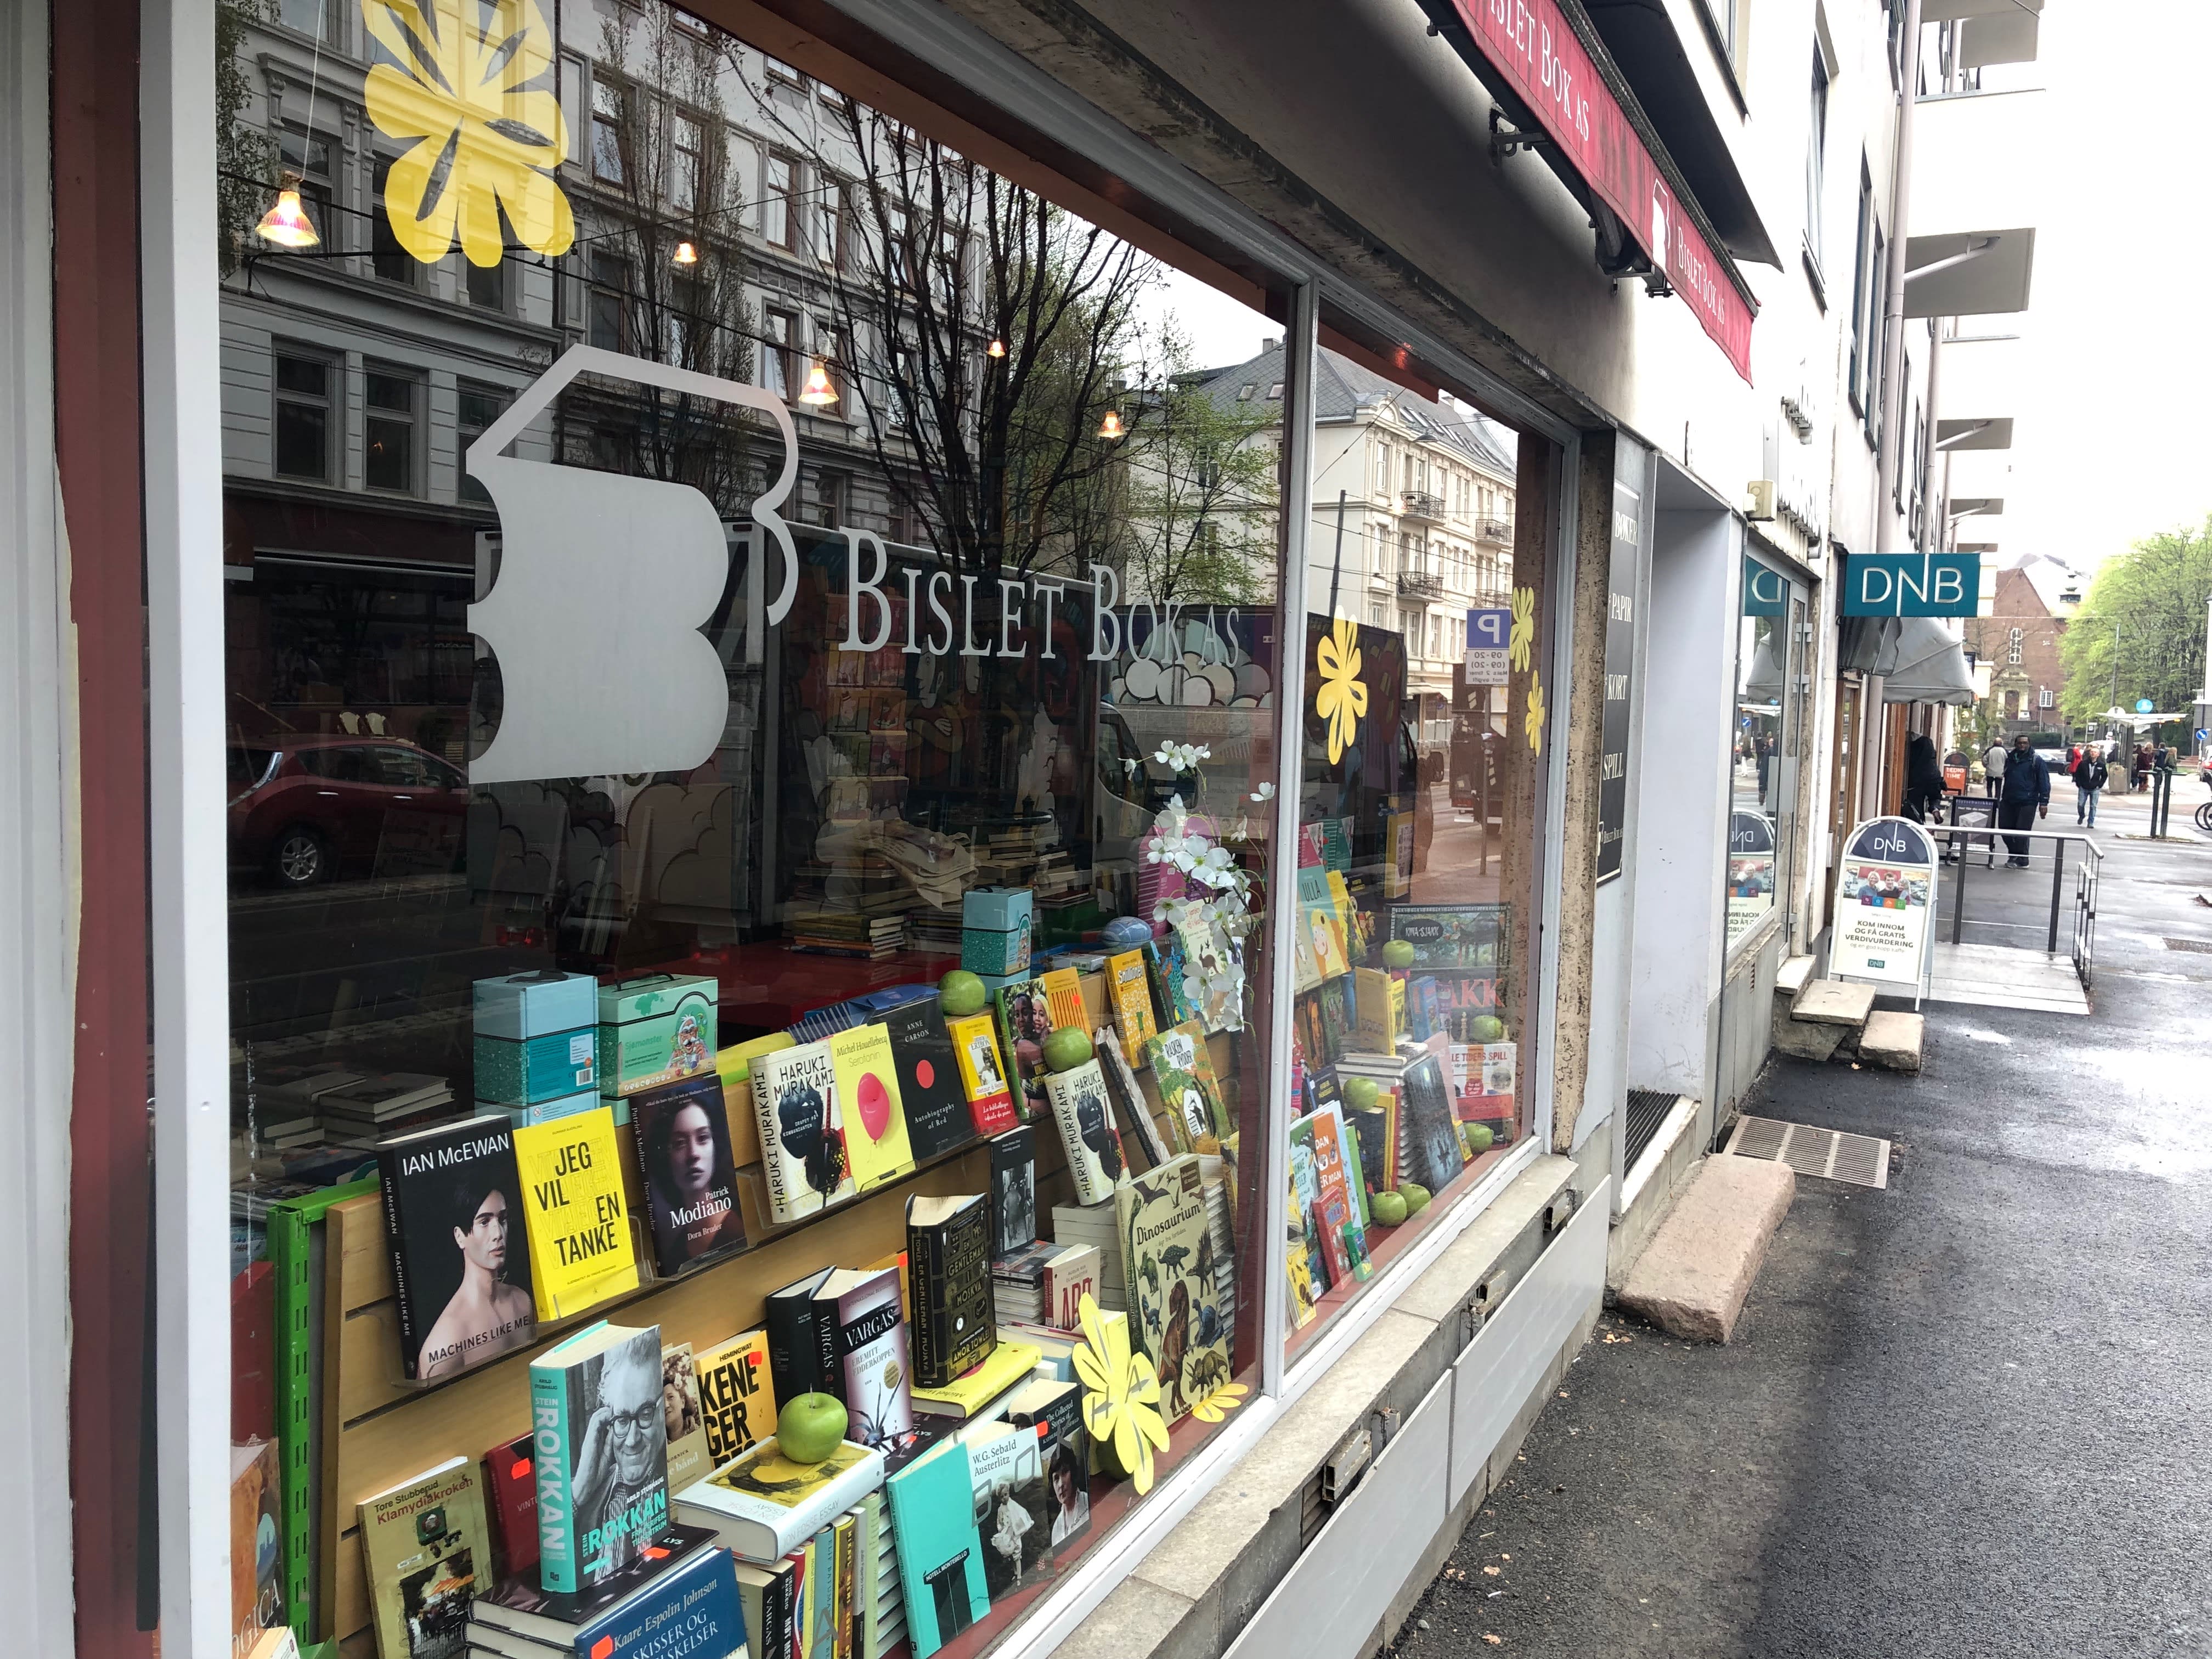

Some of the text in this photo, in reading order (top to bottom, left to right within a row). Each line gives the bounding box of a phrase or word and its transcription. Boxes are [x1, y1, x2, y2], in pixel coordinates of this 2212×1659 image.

[1542, 20, 1589, 141] BOK AS
[1678, 226, 1725, 325] BISLET BOK AS
[1615, 511, 1638, 546] BØKER
[838, 526, 1239, 669] BISLET BOK AS
[1862, 554, 1965, 617] DNB
[1611, 593, 1632, 622] PAPIR
[1608, 674, 1628, 701] KORT
[1602, 753, 1623, 781] SPILL
[1302, 879, 1322, 902] ULLA
[1845, 934, 1914, 948] VERDIVURDERING
[1877, 923, 1905, 931] INNOM
[1878, 930, 1905, 939] GRATIS
[905, 1029, 930, 1042] CARSON
[906, 1020, 923, 1031] ANNE
[836, 1036, 888, 1057] Michel Houellebecq
[1488, 1052, 1508, 1060] SPILL
[779, 1055, 826, 1082] HARUKI
[1073, 1070, 1101, 1092] HARUKI
[774, 1069, 835, 1101] MURAKAMI
[1071, 1081, 1107, 1107] MURAKAMI
[632, 1107, 641, 1135] Patrick
[914, 1103, 955, 1124] Autobiography
[928, 1116, 947, 1130] of Red
[754, 1072, 785, 1206] HARUKI MURAKAMI
[1054, 1084, 1091, 1192] HARUKI MURAKAMI
[403, 1132, 509, 1176] IAN McEWAN
[555, 1142, 592, 1176] JEG
[636, 1137, 646, 1172] Modiano
[1328, 1170, 1342, 1183] MAN
[534, 1180, 570, 1211] VIL
[596, 1191, 621, 1224] EN
[704, 1186, 729, 1201] Patrick
[387, 1195, 398, 1234] McEWAN
[669, 1197, 731, 1229] Modiano
[1136, 1204, 1201, 1246] Dinosaurium
[554, 1221, 618, 1267] TANKE
[687, 1222, 723, 1241] Dora Bruder
[947, 1242, 985, 1277] GENTLEMAN
[394, 1252, 405, 1299] MACHINES
[404, 1323, 410, 1336] ME
[956, 1280, 982, 1307] MOSKVA
[428, 1315, 529, 1363] MACHINES LIKE ME
[820, 1315, 834, 1368] VARGAS
[845, 1308, 895, 1347] VARGAS
[719, 1342, 752, 1362] HEMINGWAY
[953, 1345, 970, 1363] AMOR
[696, 1352, 760, 1414] KENE
[535, 1397, 558, 1406] STEIN
[1046, 1400, 1074, 1424] The Collected
[702, 1401, 752, 1457] GER
[1051, 1417, 1065, 1429] Stories
[972, 1439, 1017, 1464] W.G. Sebald
[974, 1455, 1011, 1477] Austerlitz
[535, 1408, 566, 1552] ROKKAN
[627, 1491, 640, 1504] ARILD
[640, 1476, 664, 1497] STUBHAUG
[374, 1480, 439, 1513] Tore Stubberud
[377, 1474, 473, 1526] Klamydiakroken
[588, 1487, 666, 1555] ROKKAN
[782, 1498, 840, 1548] JON FOSSE ESSAY
[663, 1537, 685, 1545] LYS
[926, 1550, 968, 1582] HOTELL MONTEBELLO
[614, 1578, 717, 1651] Kaare Espolin Johnson
[632, 1608, 707, 1659] SKISSER OG
